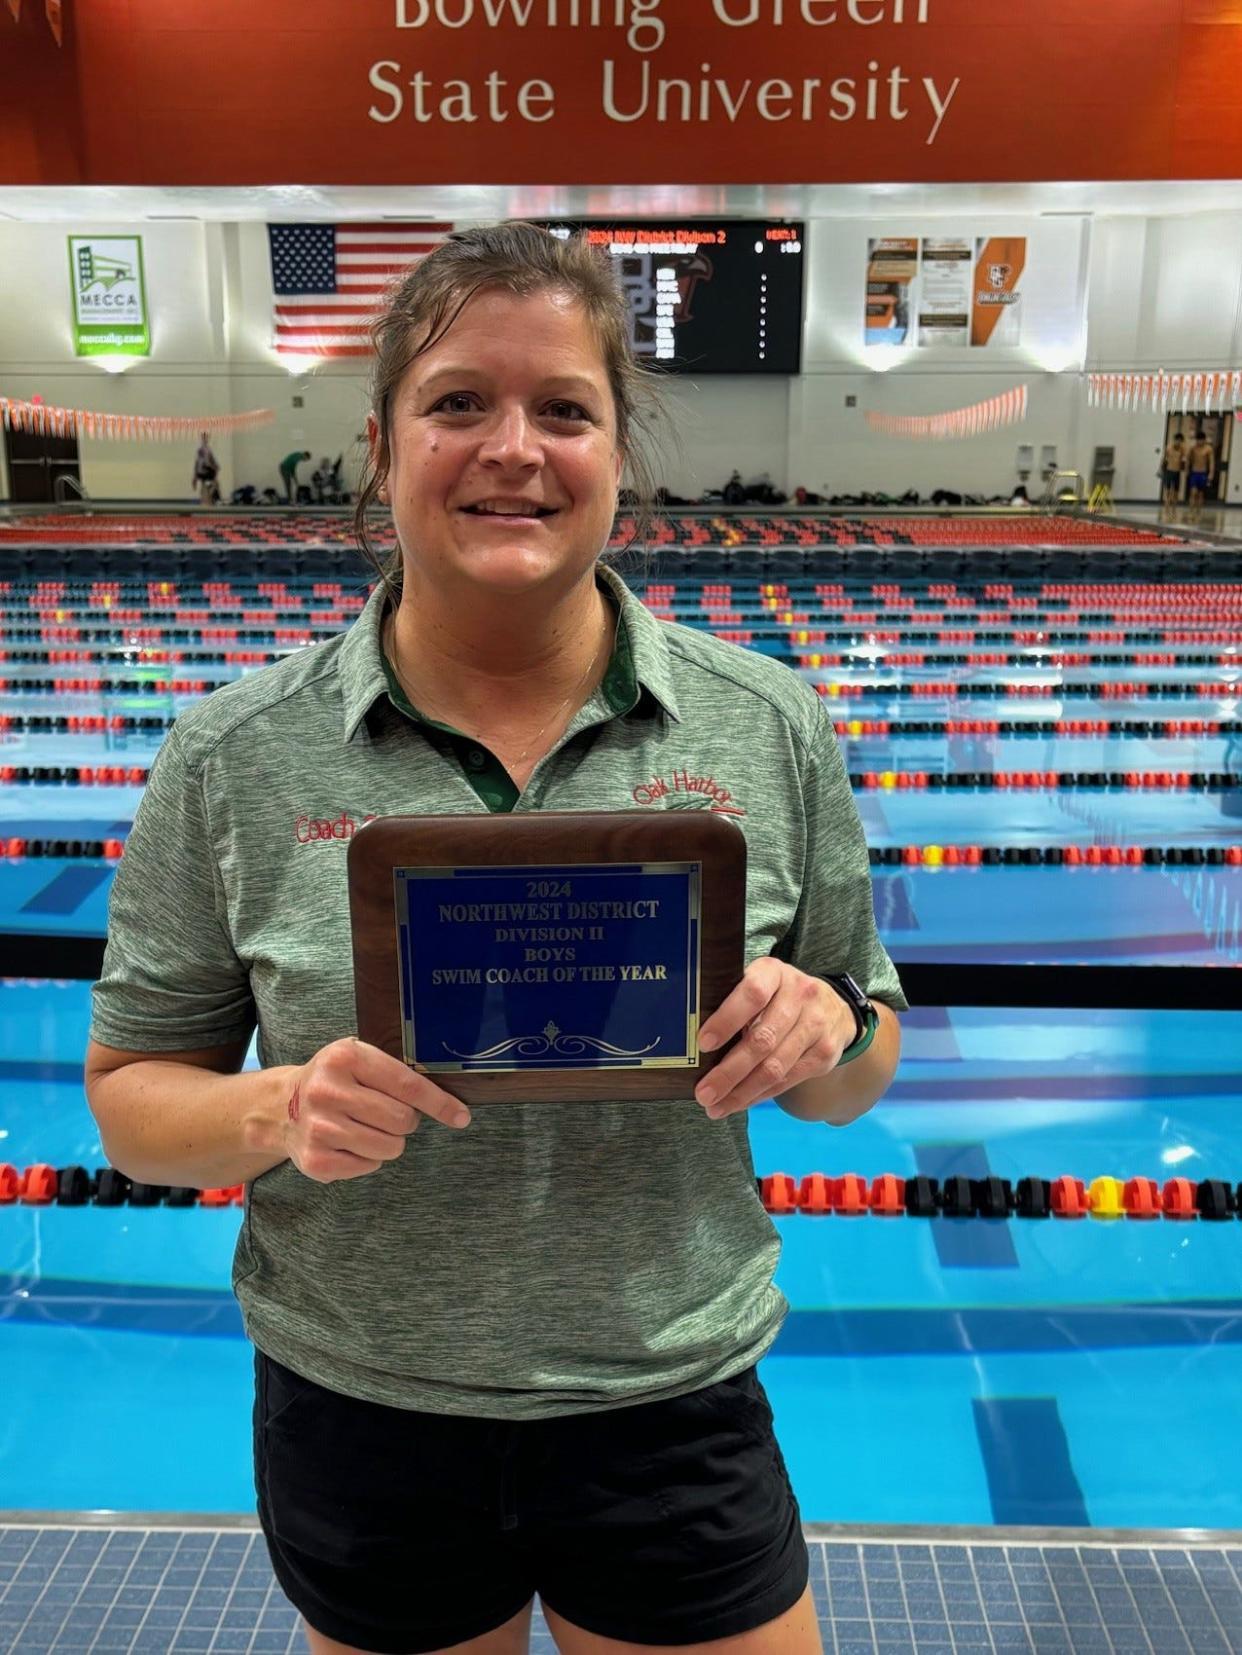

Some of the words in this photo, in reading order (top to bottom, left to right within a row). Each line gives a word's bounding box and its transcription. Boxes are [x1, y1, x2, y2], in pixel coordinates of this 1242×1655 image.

[368, 60, 556, 123] State
[602, 60, 960, 145] University
[717, 230, 726, 243] 2
[80, 294, 137, 306] MECCA
[632, 774, 670, 805] Oak
[294, 810, 356, 843] Coach
[526, 880, 572, 898] 2024
[438, 902, 562, 922] NORTHWEST
[567, 900, 660, 920] DISTRICT
[495, 926, 584, 942] DIVISION
[589, 926, 605, 940] II
[523, 947, 576, 962] BOYS
[431, 968, 482, 985] SWIM
[485, 967, 549, 984] COACH
[552, 966, 577, 982] OF
[579, 965, 616, 982] THE
[619, 964, 668, 981] YEAR
